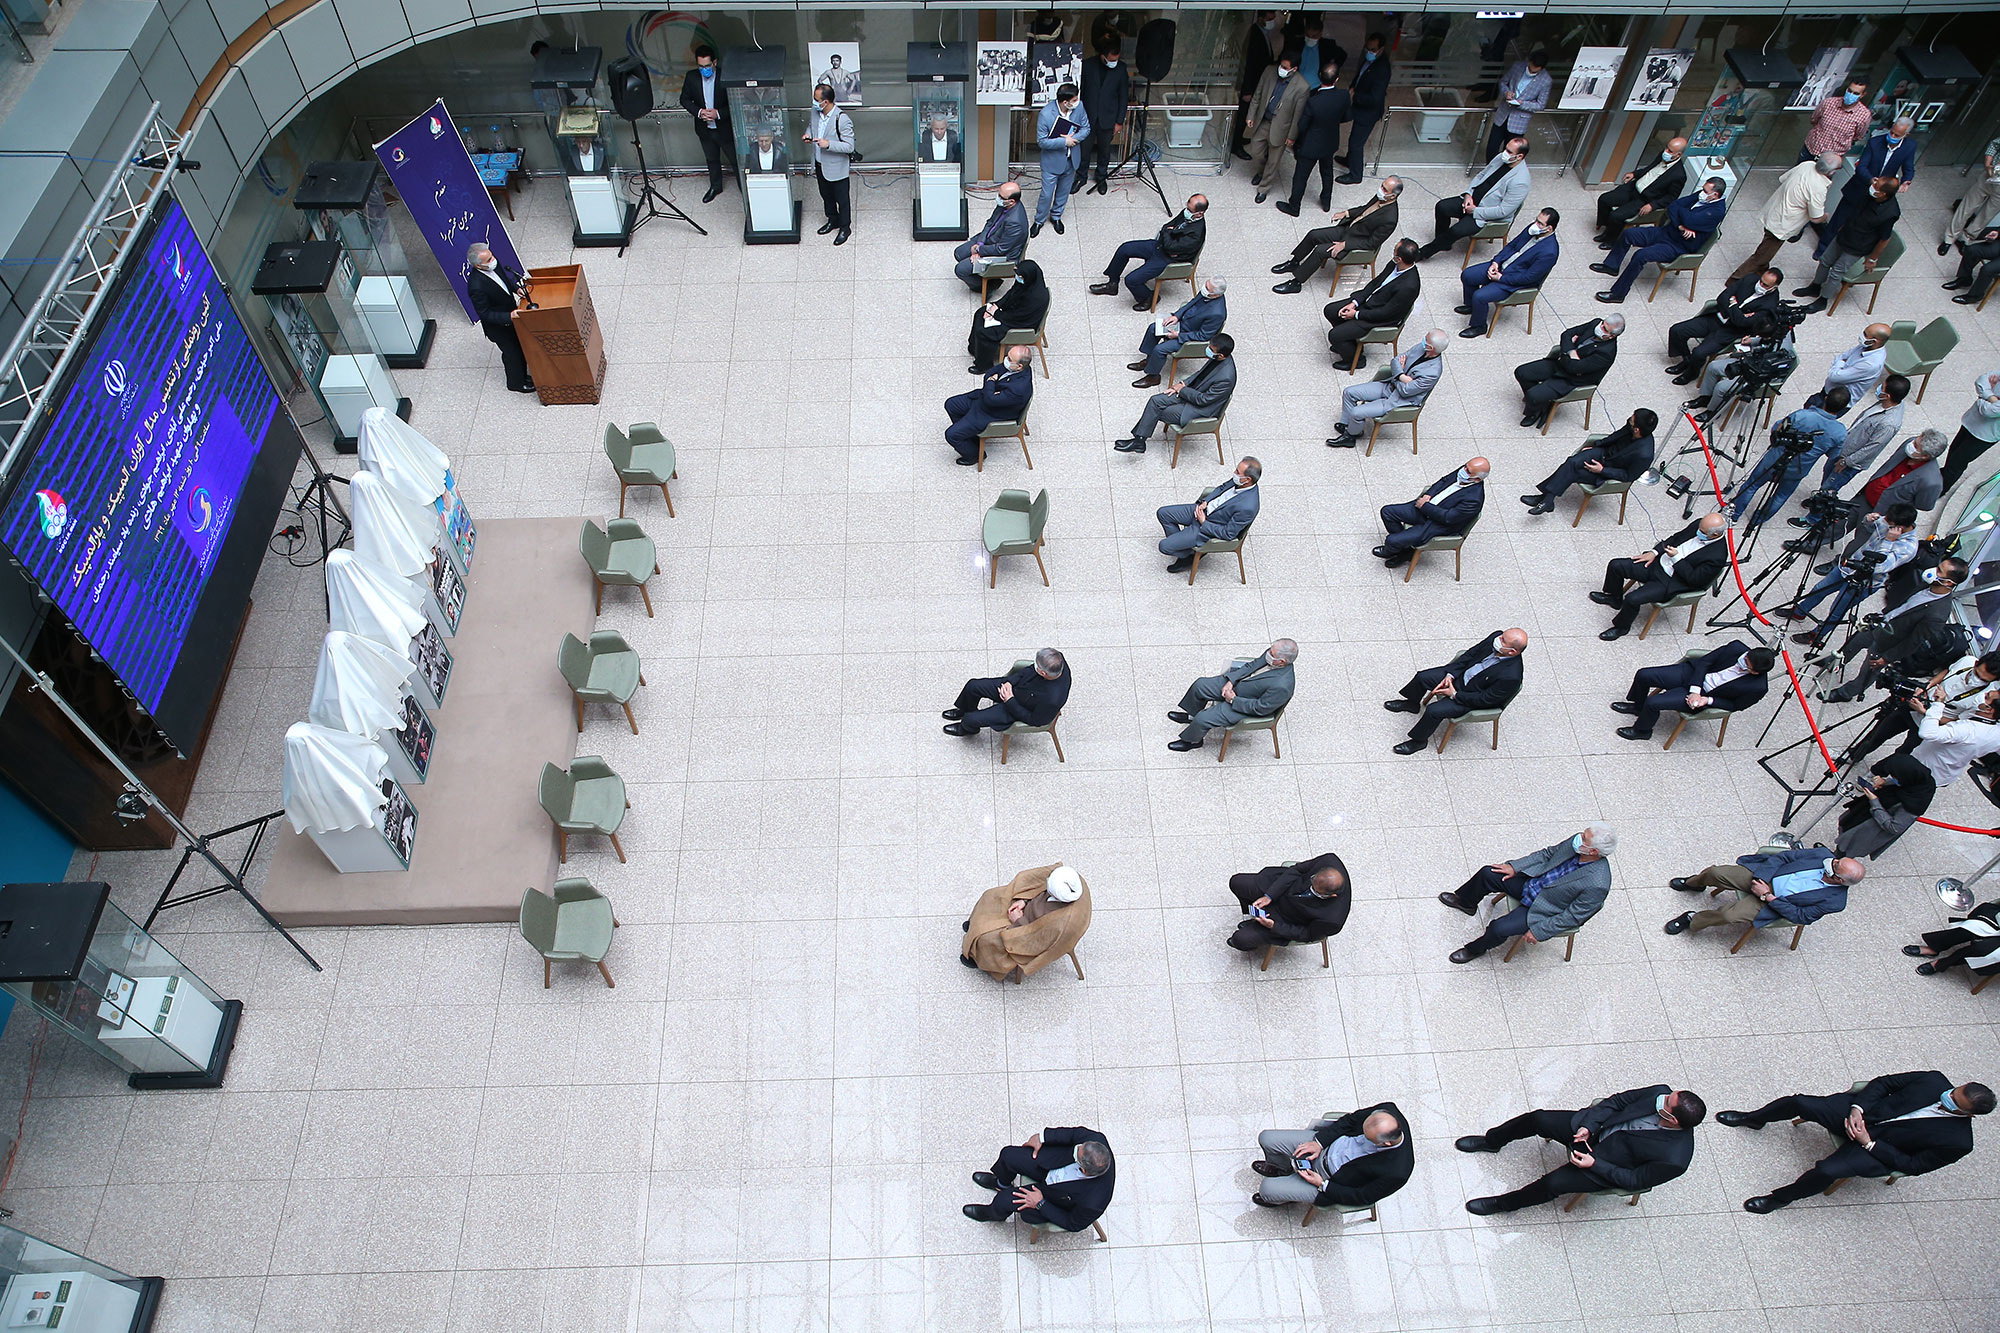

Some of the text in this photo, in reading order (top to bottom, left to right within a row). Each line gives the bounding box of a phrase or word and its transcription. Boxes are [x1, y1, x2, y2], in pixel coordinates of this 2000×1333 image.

[434, 179, 447, 209] مقدم
[181, 323, 200, 368] رونمایی
[214, 320, 222, 342] علی
[172, 359, 181, 379] از
[159, 370, 176, 414] تندیس
[185, 381, 196, 406] رحیم
[144, 411, 159, 444] مدال
[177, 402, 186, 425] علی
[200, 422, 210, 443] ساعت
[129, 431, 144, 471] آوران
[152, 443, 166, 477] ابراهیم
[143, 403, 201, 530] و پهلوان شهید ابراهیم هادی
[107, 465, 130, 515] المپیک
[178, 475, 186, 491] شنبه
[102, 515, 110, 530] و
[127, 505, 139, 526] زنده
[120, 526, 130, 539] یاد
[72, 525, 106, 587] پارالمپیک
[107, 539, 123, 570] سیامند
[93, 570, 110, 603] رحمان
